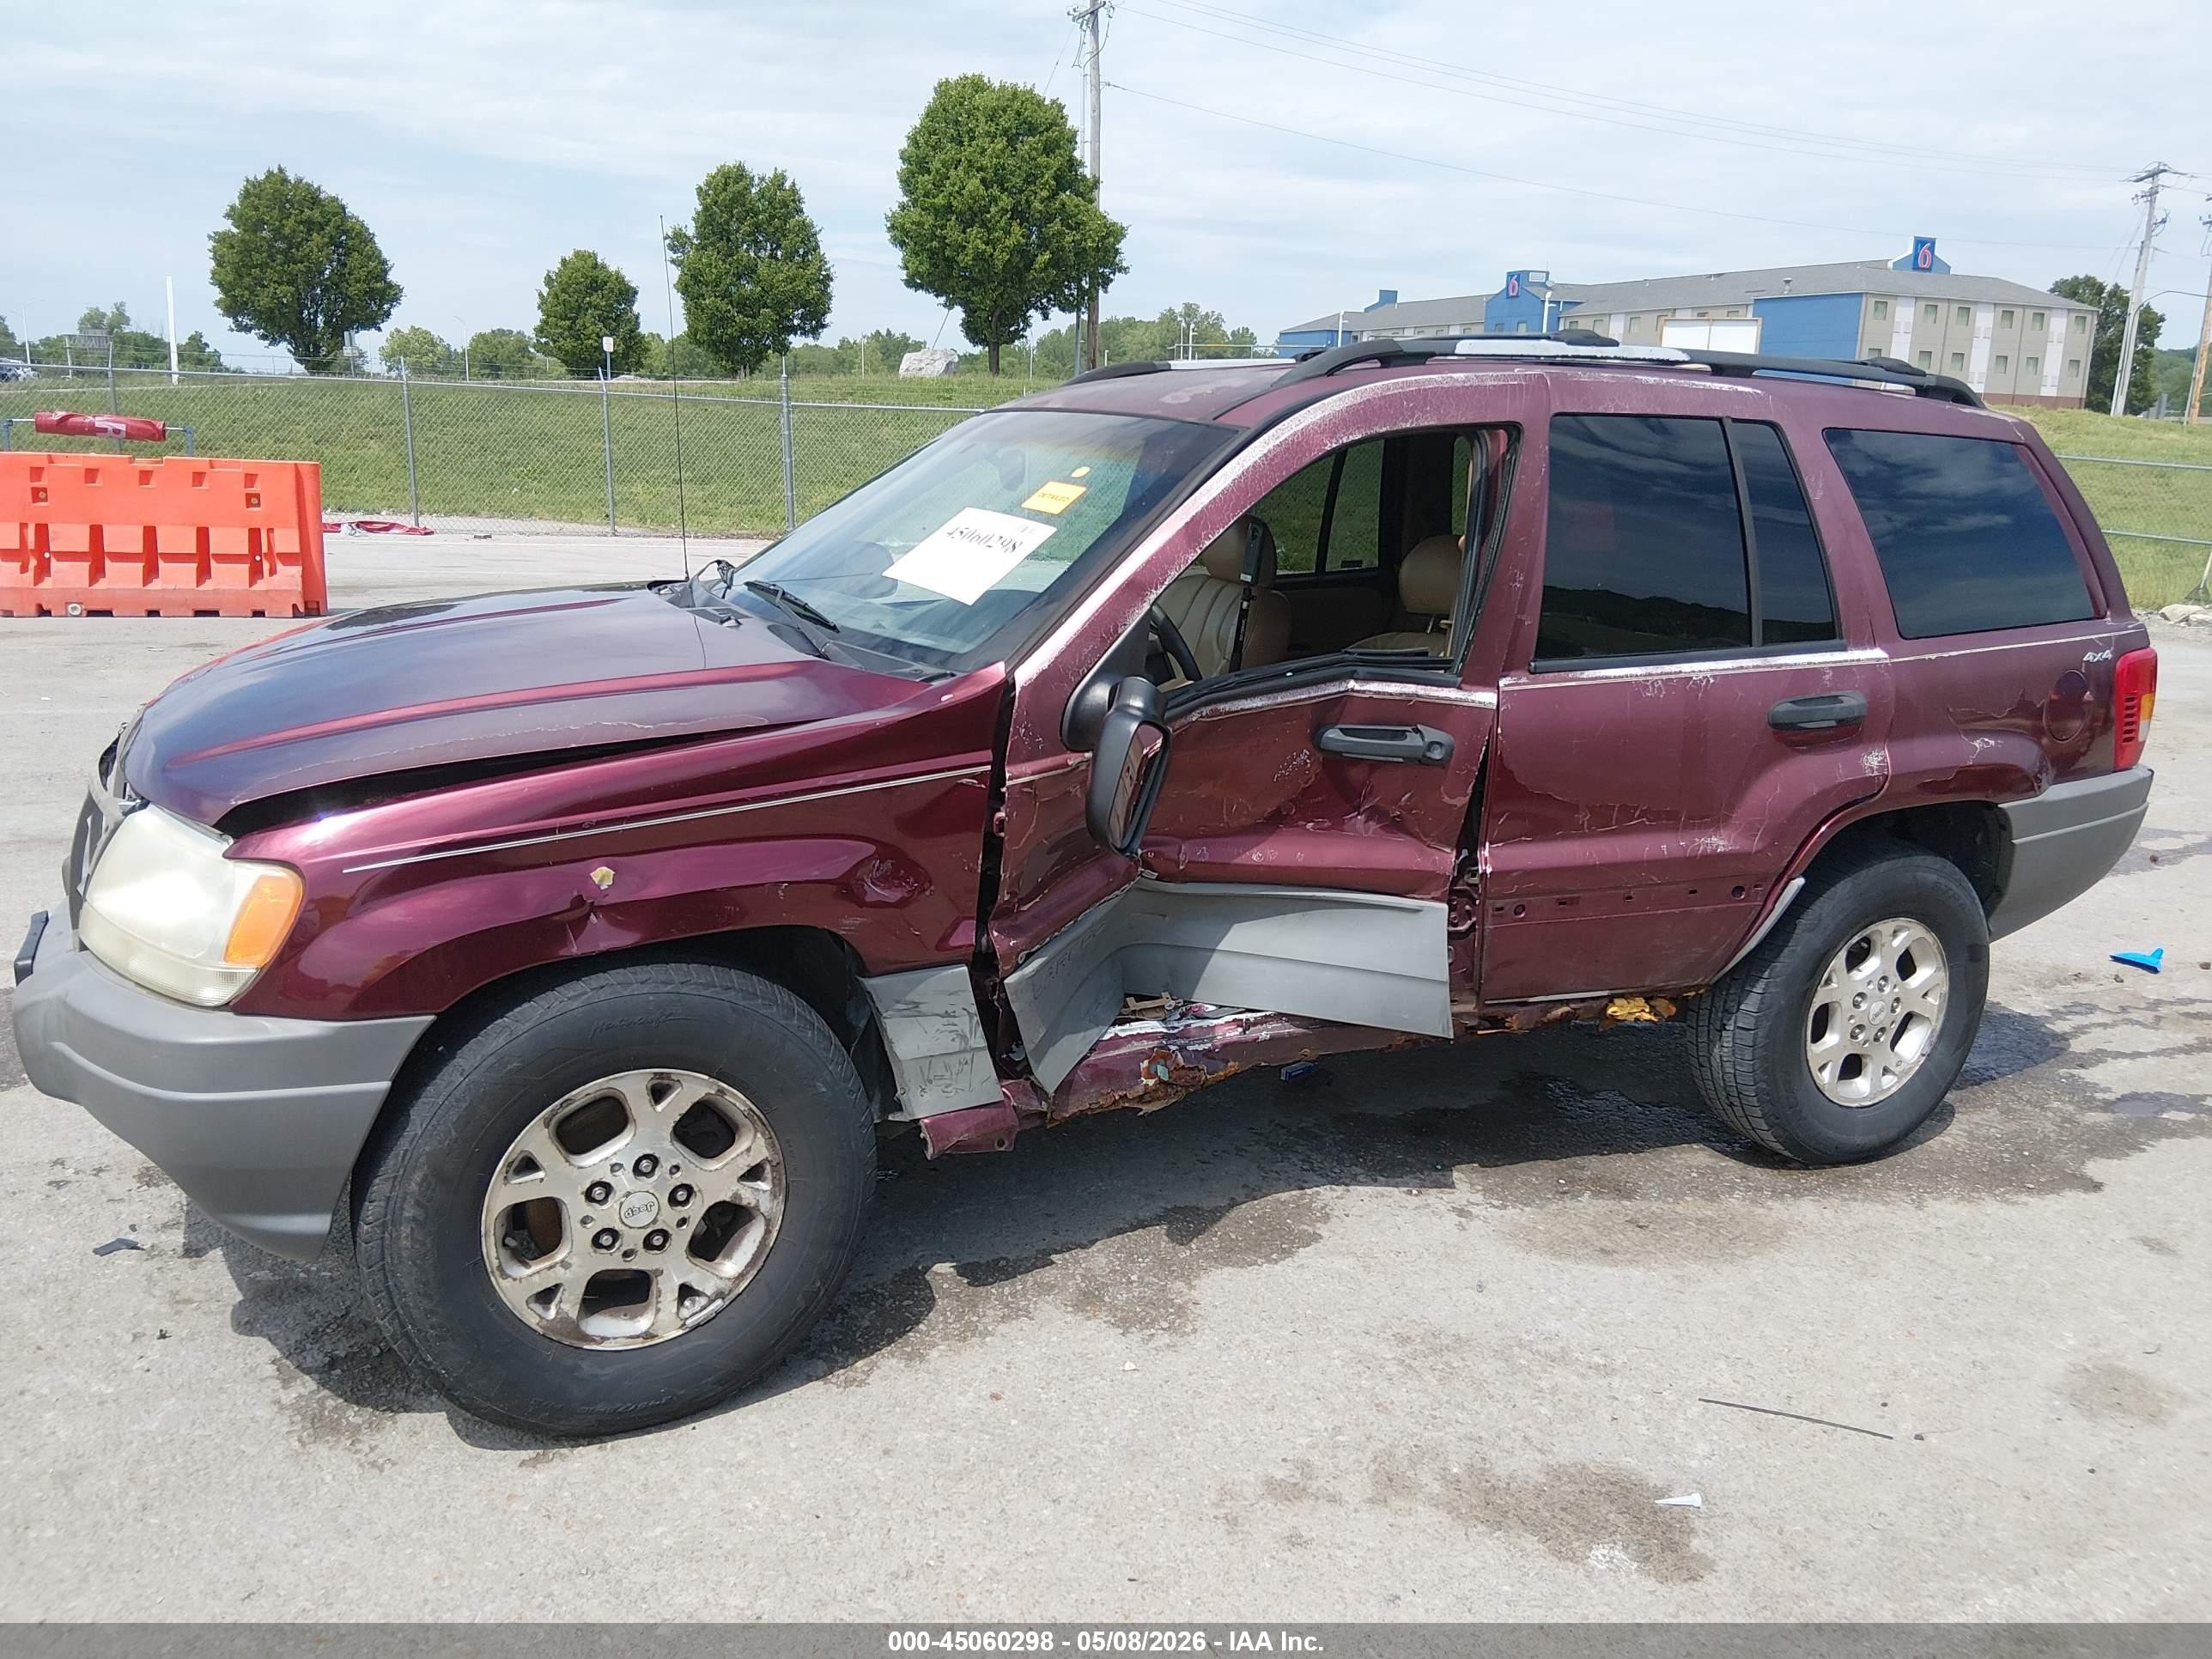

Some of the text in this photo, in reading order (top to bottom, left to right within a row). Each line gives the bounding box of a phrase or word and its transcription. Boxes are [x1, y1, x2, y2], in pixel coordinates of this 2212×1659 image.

[1917, 242, 1932, 269] 6
[1508, 274, 1519, 297] 6
[2082, 649, 2112, 663] 4x4
[623, 1200, 655, 1219] Jeep
